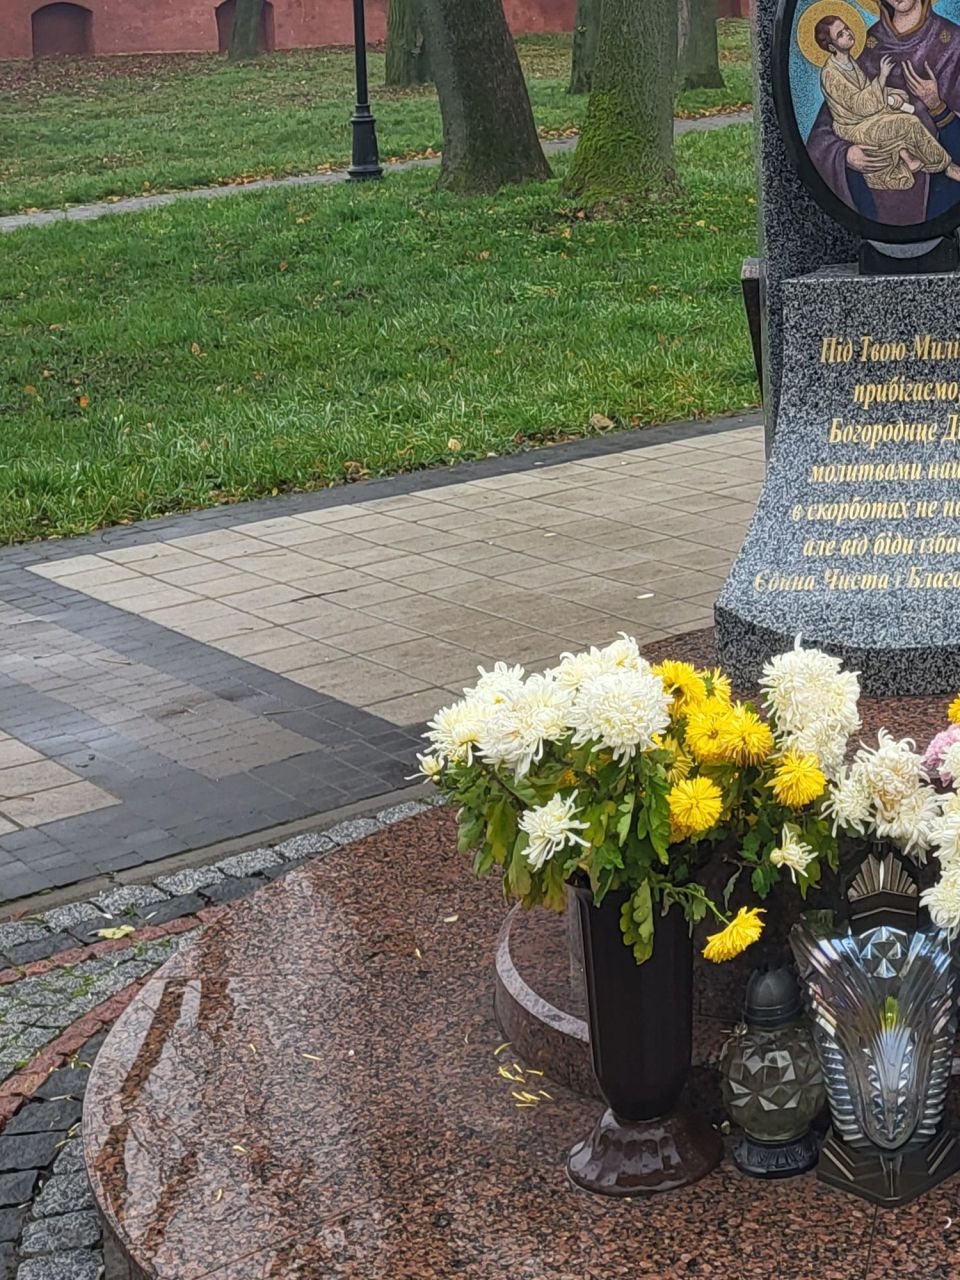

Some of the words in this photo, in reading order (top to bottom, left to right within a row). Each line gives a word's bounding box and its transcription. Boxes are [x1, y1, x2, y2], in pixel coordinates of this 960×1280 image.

[820, 336, 853, 363] Під
[860, 335, 906, 362] Твою
[829, 417, 938, 449] Богородице
[811, 462, 922, 483] молитвами
[792, 504, 801, 520] в
[806, 496, 910, 527] скорботах
[914, 500, 938, 520] не
[803, 538, 836, 556] але
[840, 532, 868, 555] від
[873, 531, 915, 555] біди
[824, 568, 889, 591] Чиста
